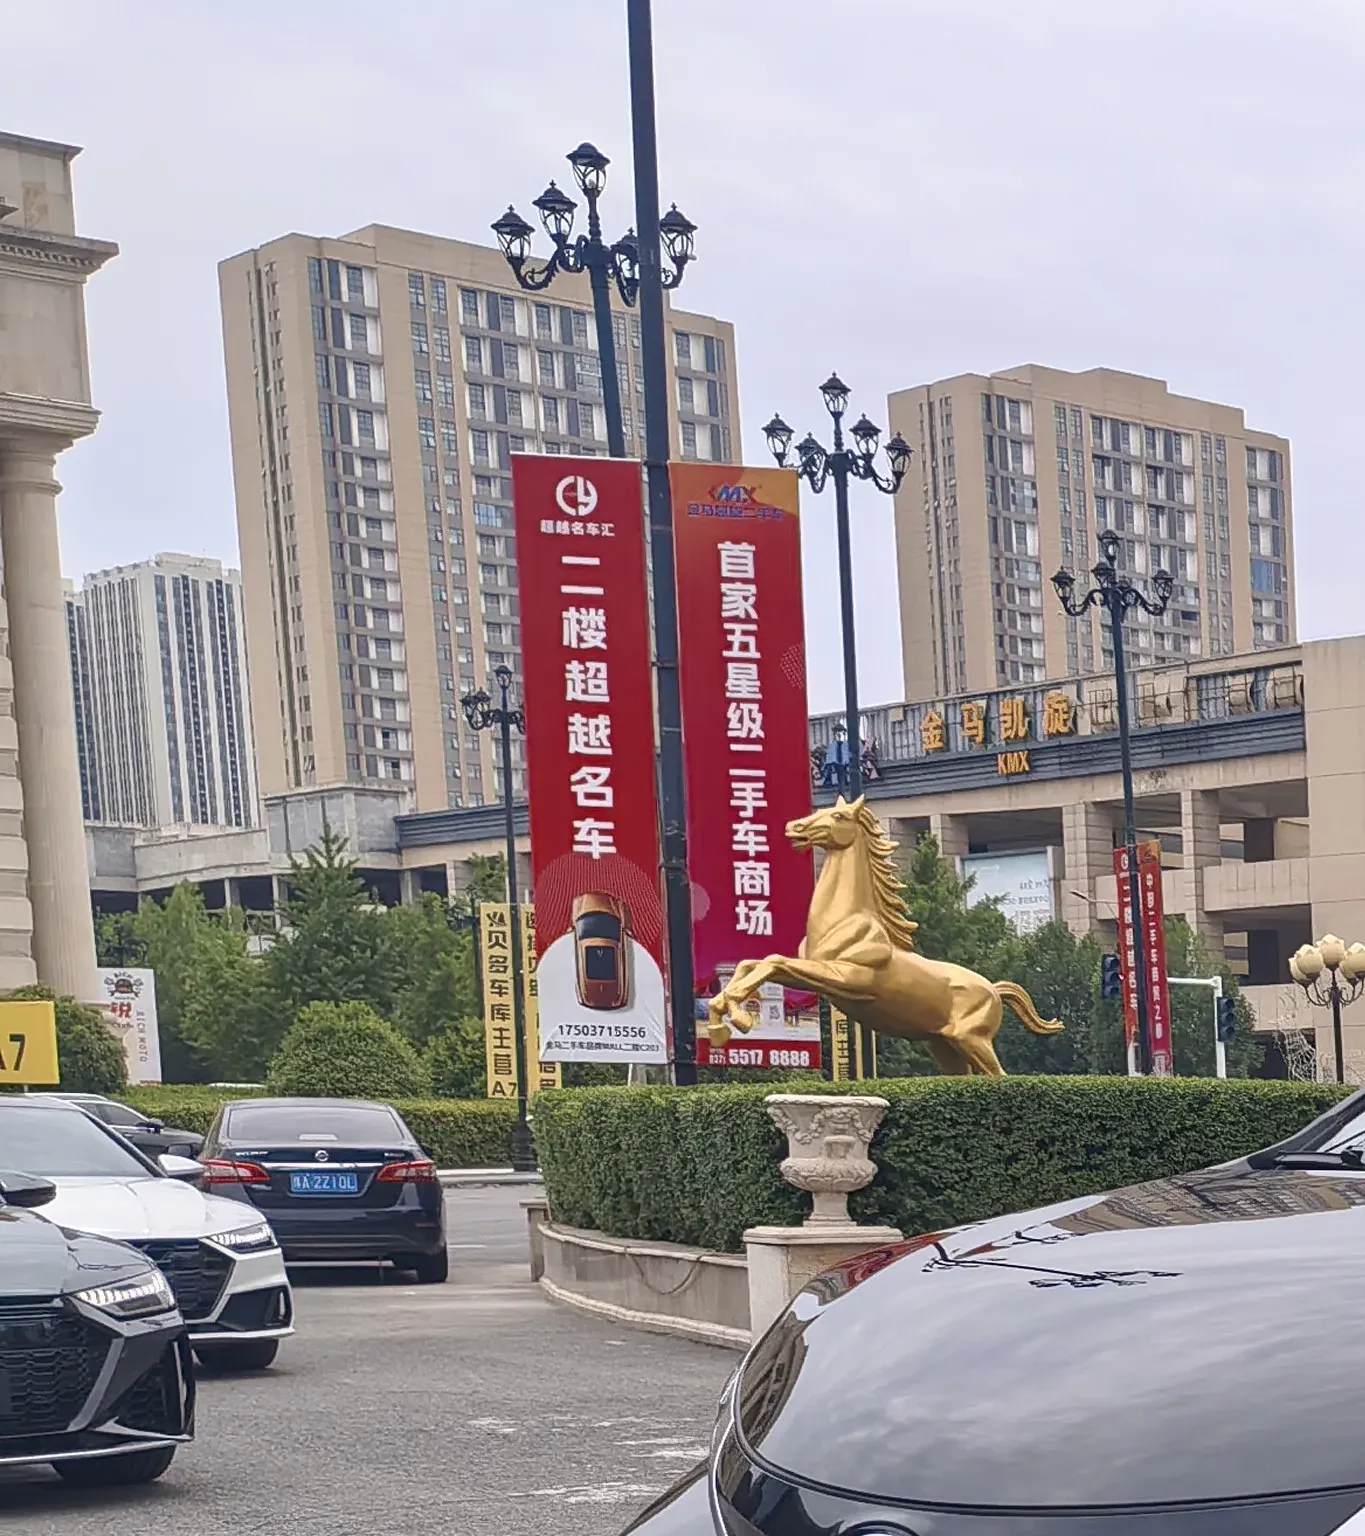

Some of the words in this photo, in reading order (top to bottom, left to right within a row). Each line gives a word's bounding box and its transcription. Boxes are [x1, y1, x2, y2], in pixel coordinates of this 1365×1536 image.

[560, 555, 617, 860] 二楼超越名车
[920, 690, 1075, 751] 金马凯旋
[717, 541, 774, 936] 首家五星级二手车商场
[998, 751, 1030, 775] KMX
[728, 1049, 763, 1065] 5517
[769, 1050, 810, 1067] 8888
